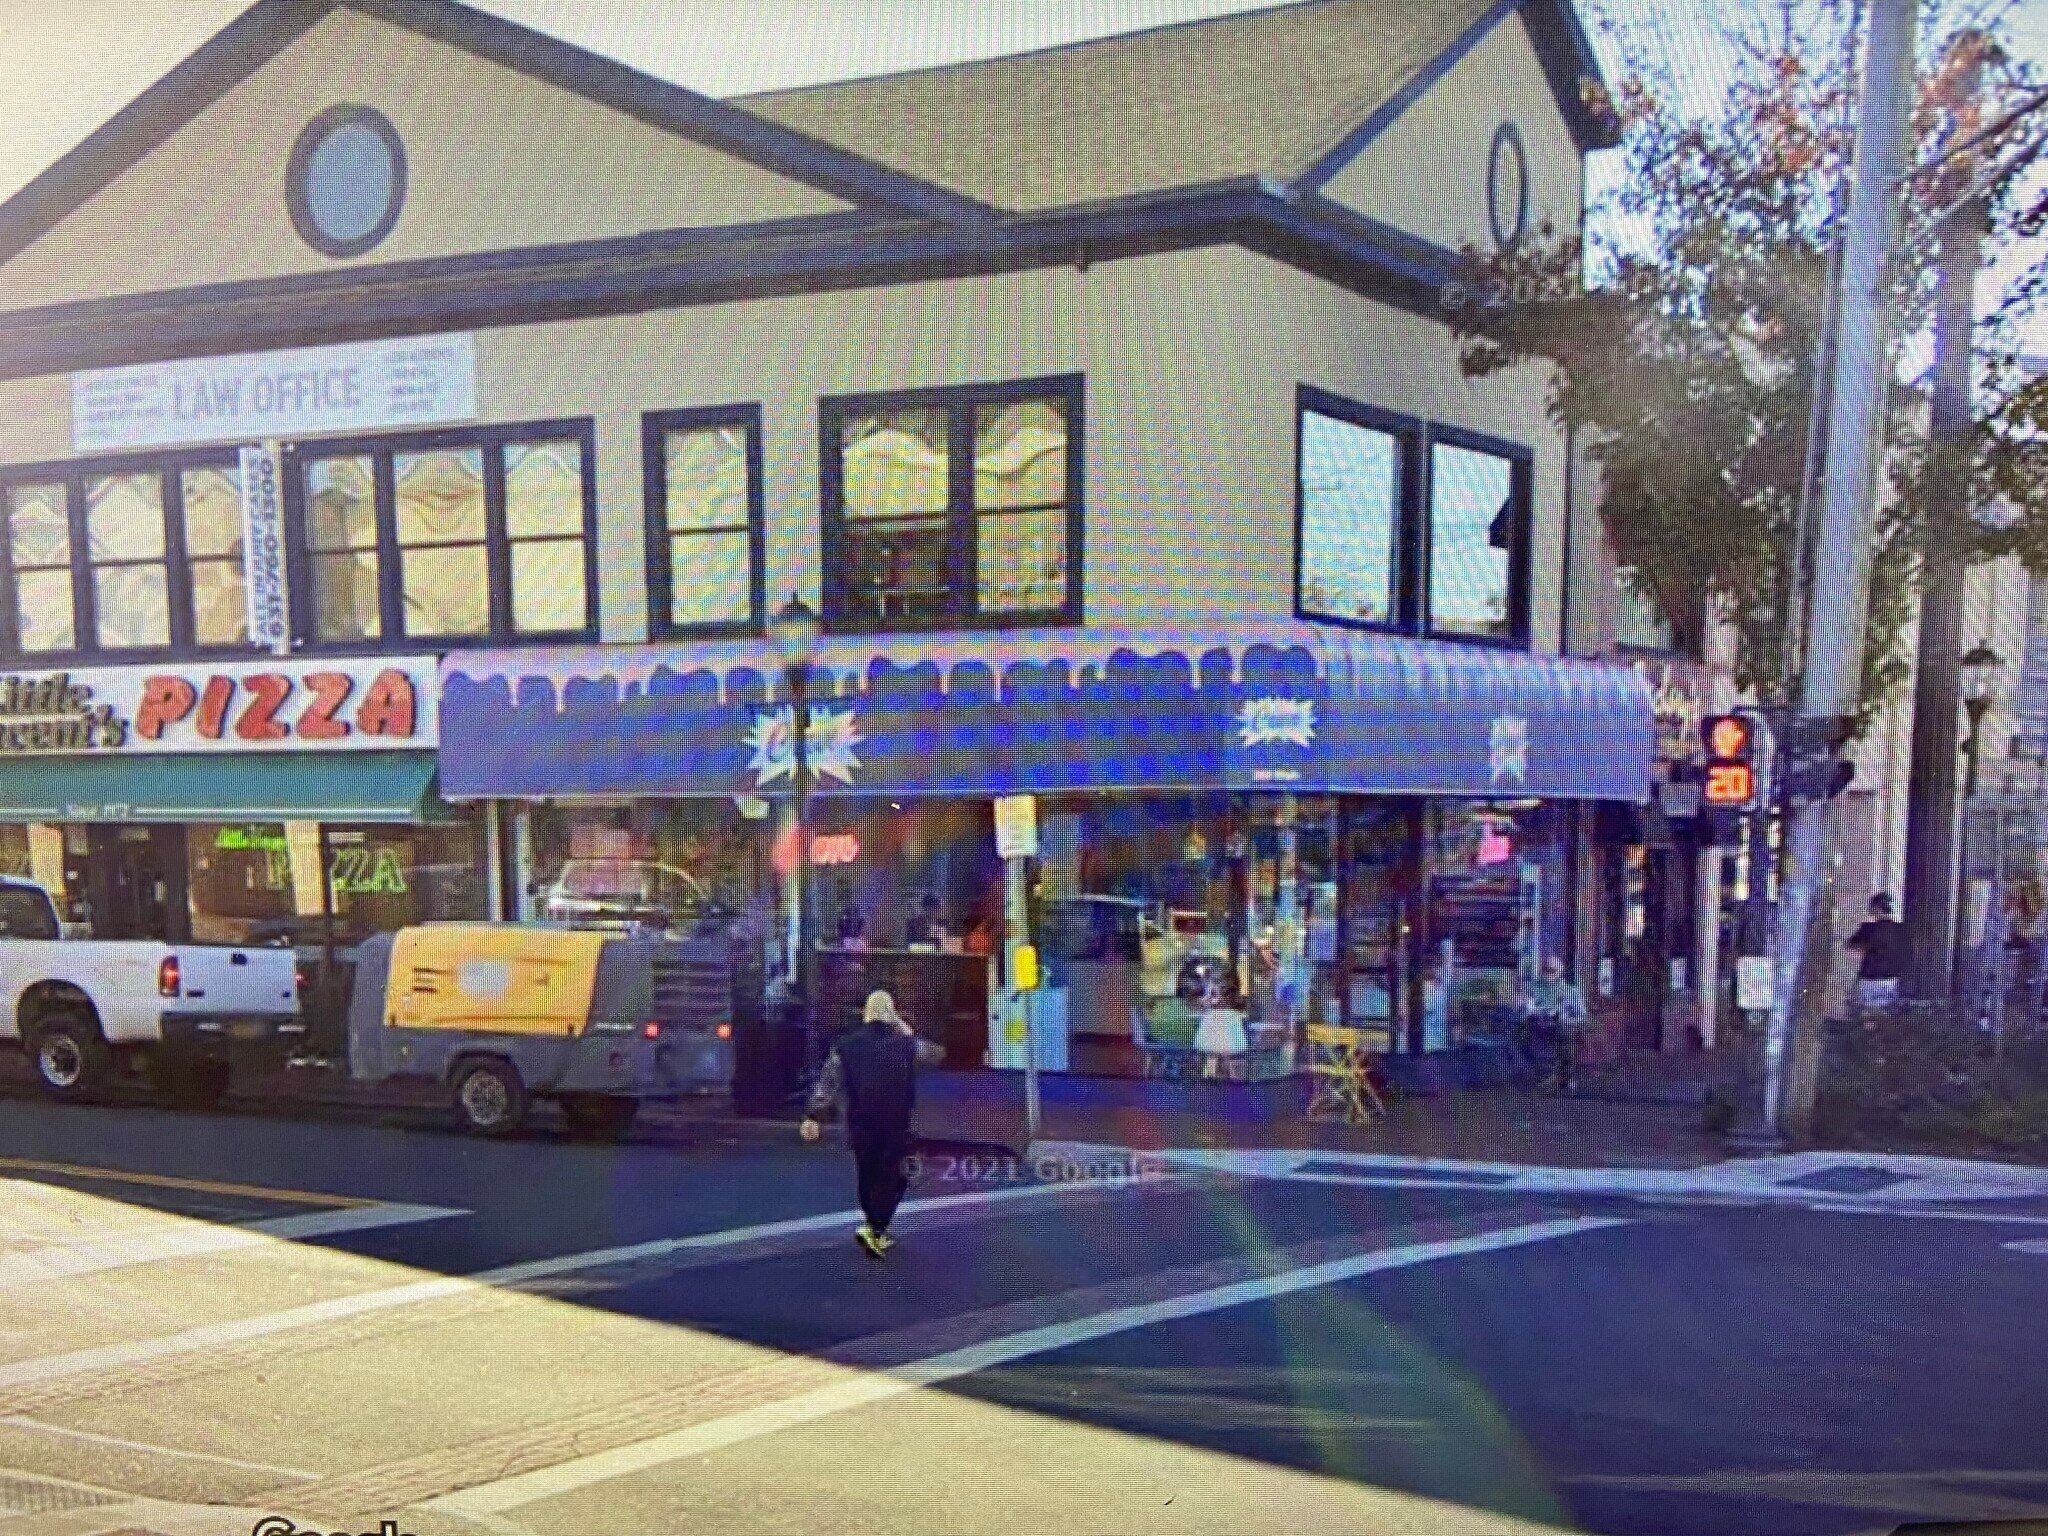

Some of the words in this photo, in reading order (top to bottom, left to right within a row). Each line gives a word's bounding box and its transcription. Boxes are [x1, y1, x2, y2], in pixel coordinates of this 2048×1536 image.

[172, 377, 243, 421] LAW
[253, 367, 361, 415] OFFICE
[136, 668, 417, 739] PIZZA
[1705, 766, 1748, 799] 20
